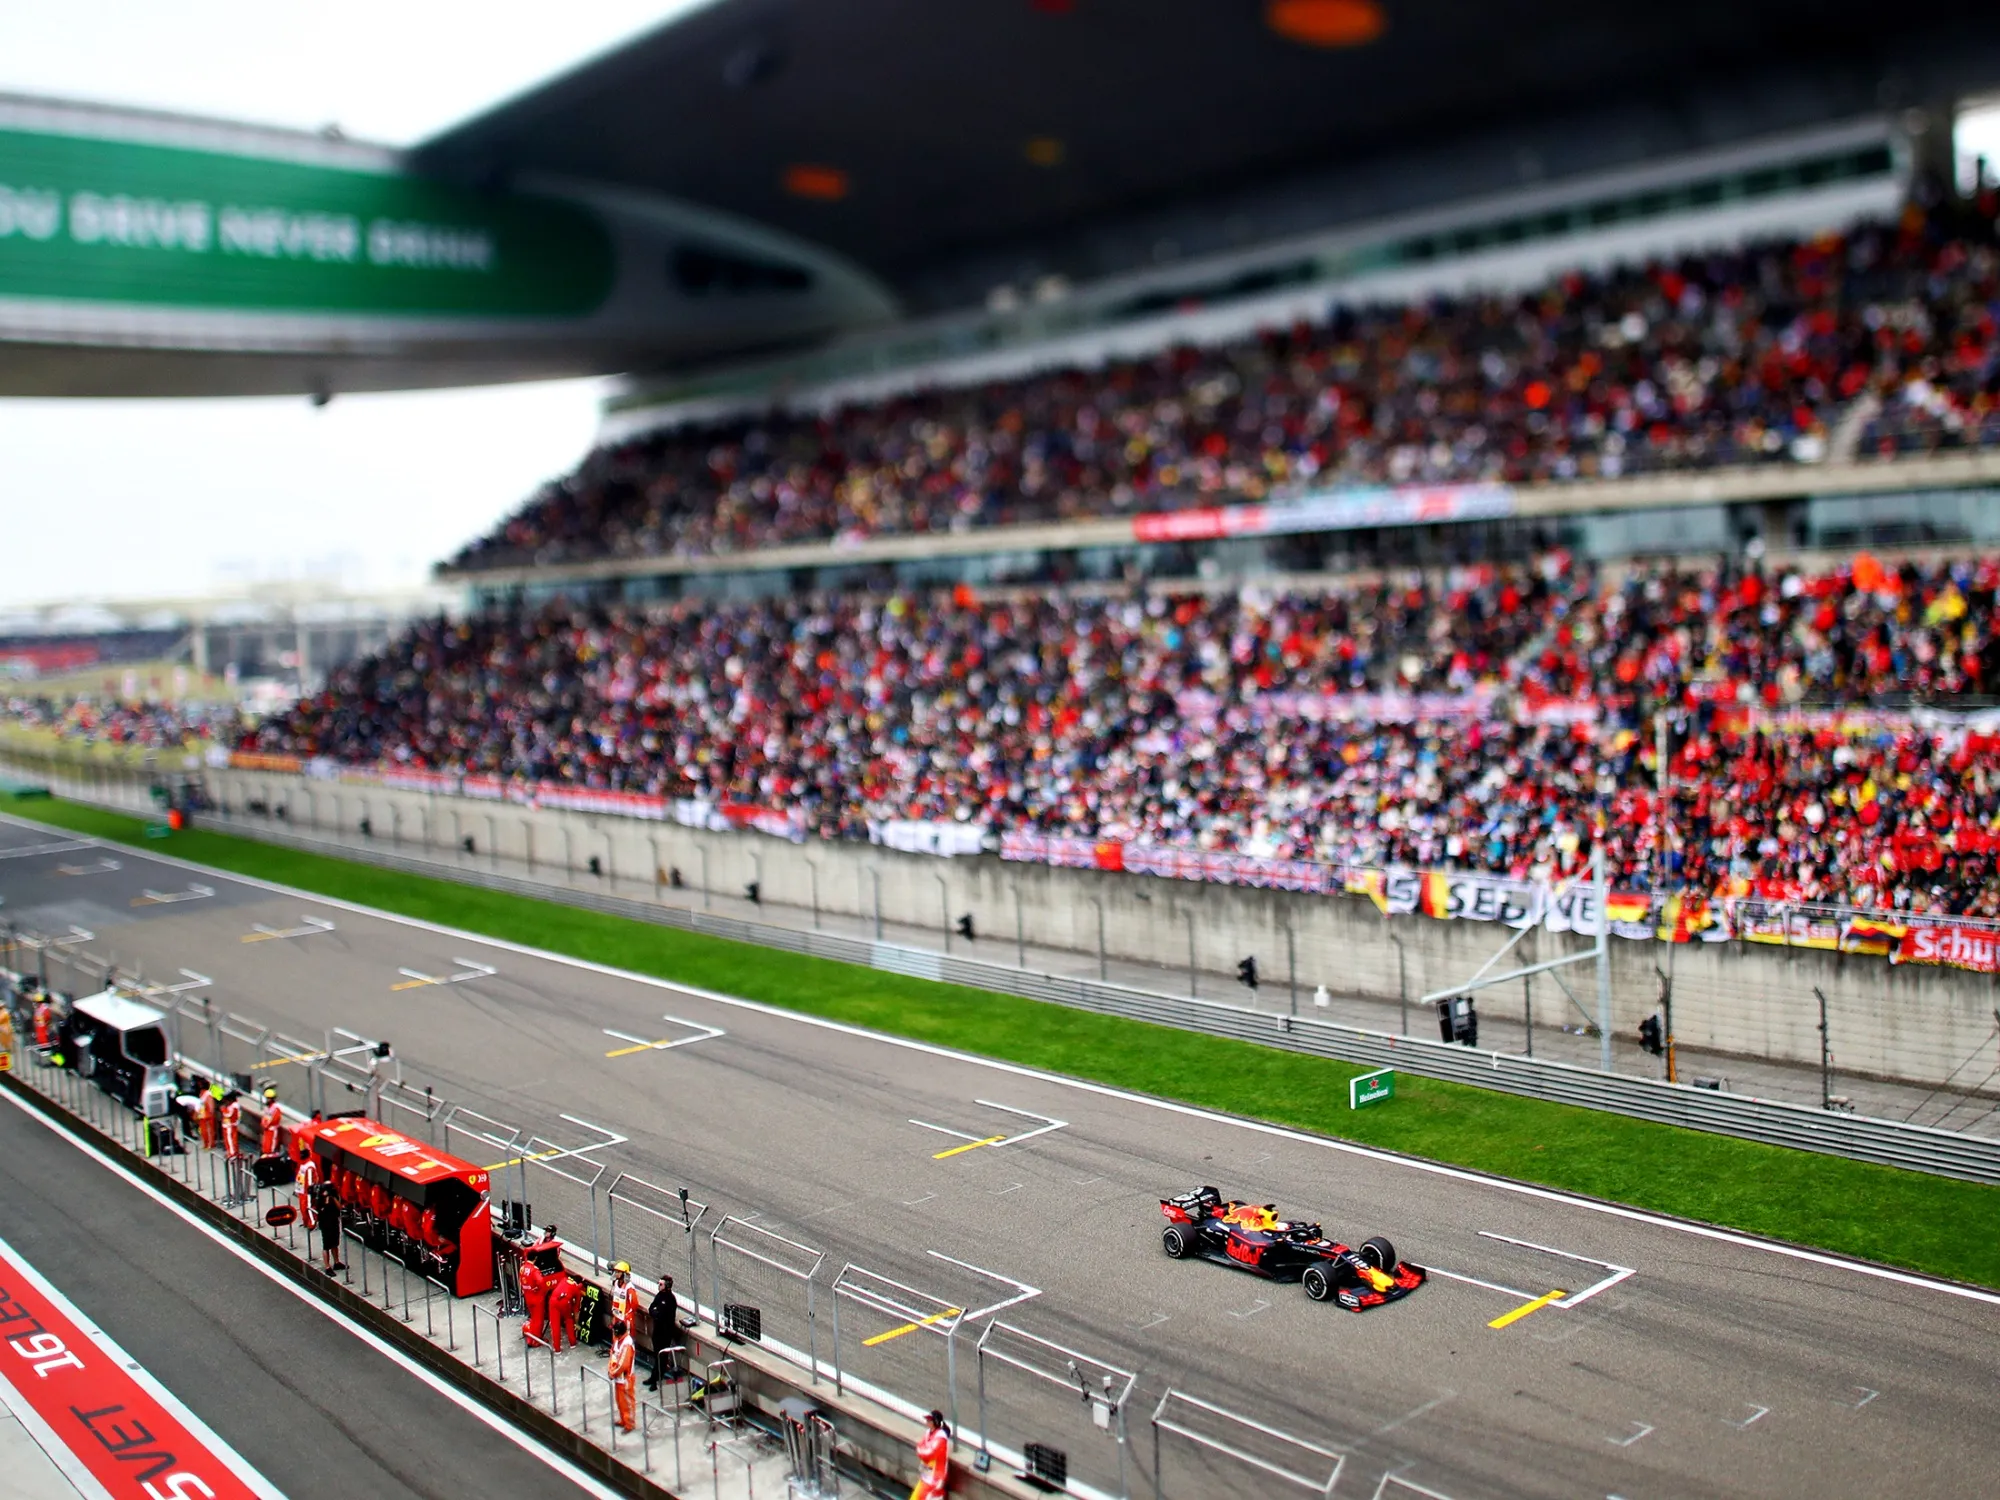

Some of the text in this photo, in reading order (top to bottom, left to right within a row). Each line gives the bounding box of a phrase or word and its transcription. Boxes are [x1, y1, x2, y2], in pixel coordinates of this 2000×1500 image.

[70, 191, 210, 251] DRIVE
[219, 206, 359, 262] NEVER
[367, 219, 493, 271] DRINK
[1913, 927, 2000, 964] Schu
